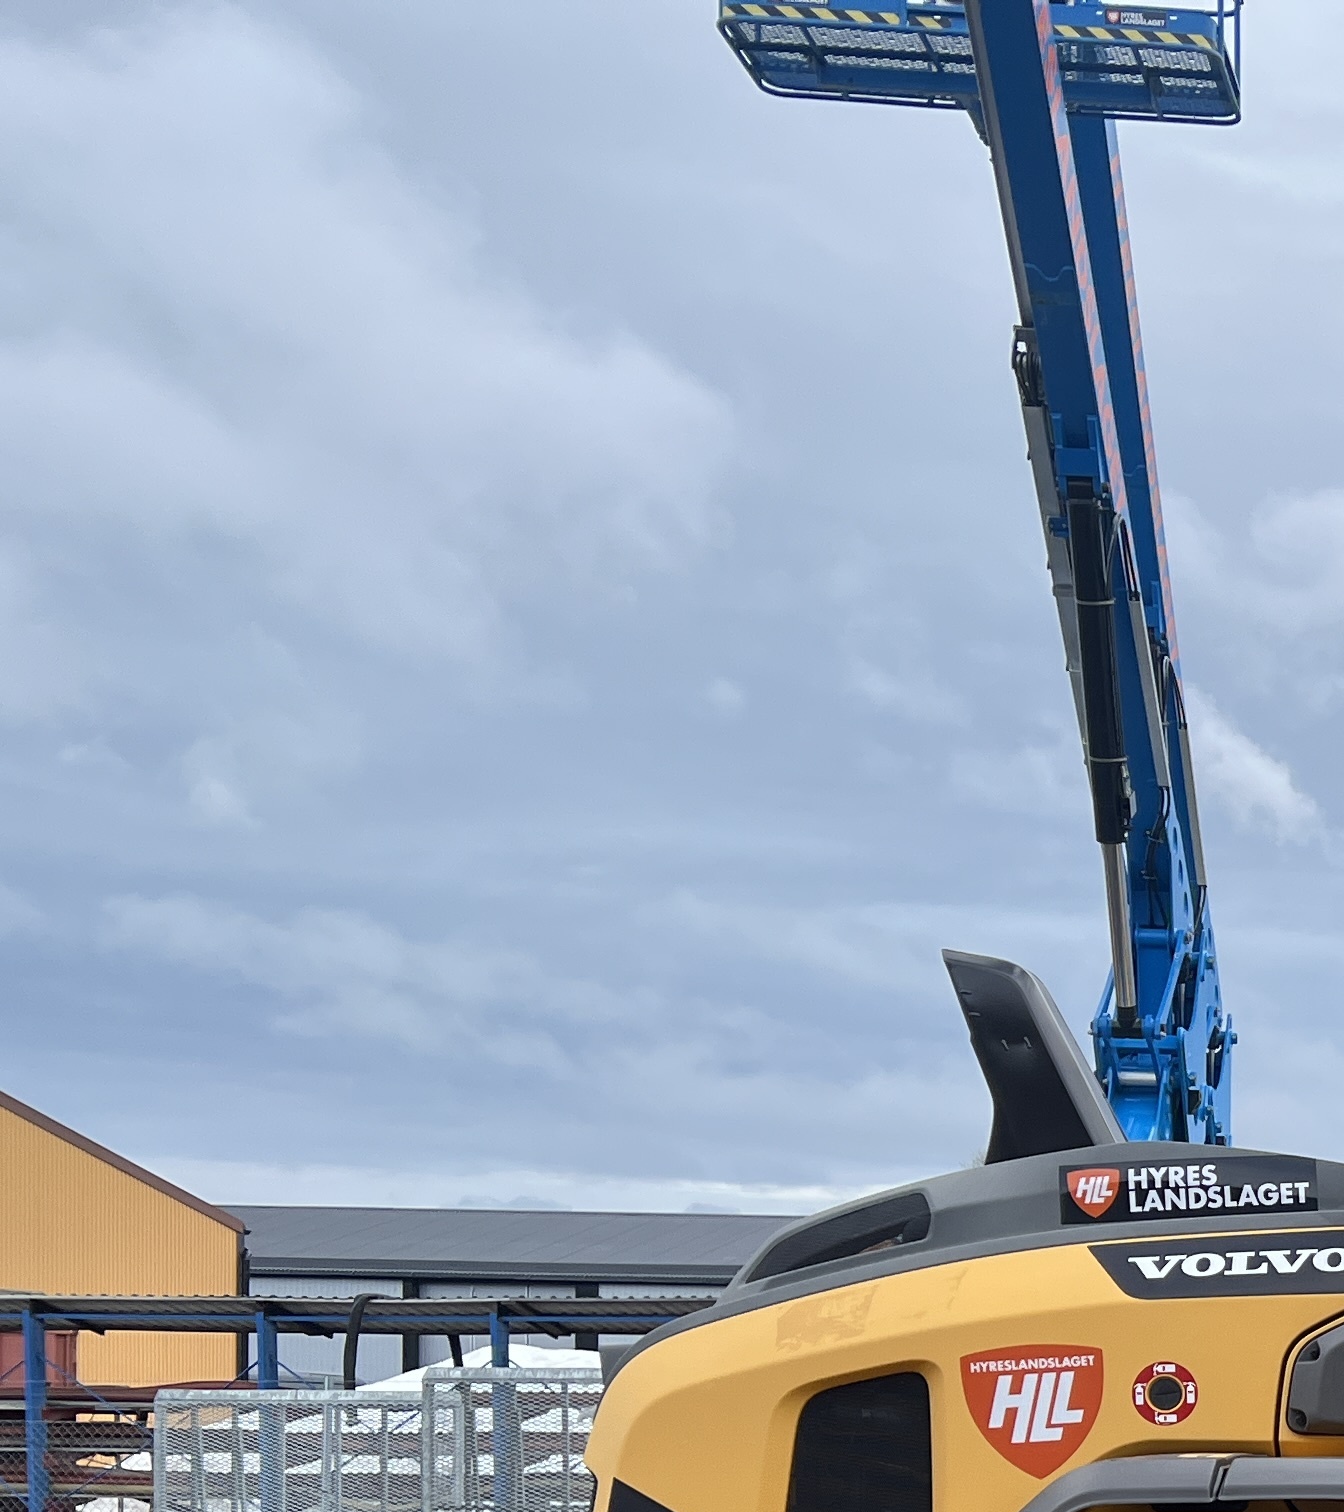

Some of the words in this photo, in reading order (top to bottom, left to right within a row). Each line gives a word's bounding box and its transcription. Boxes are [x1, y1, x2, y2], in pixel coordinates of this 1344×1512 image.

[1128, 1164, 1218, 1190] HYRES
[1128, 1182, 1310, 1213] LANDSLAGET
[970, 1355, 1095, 1373] HYRESLANDSLAGET
